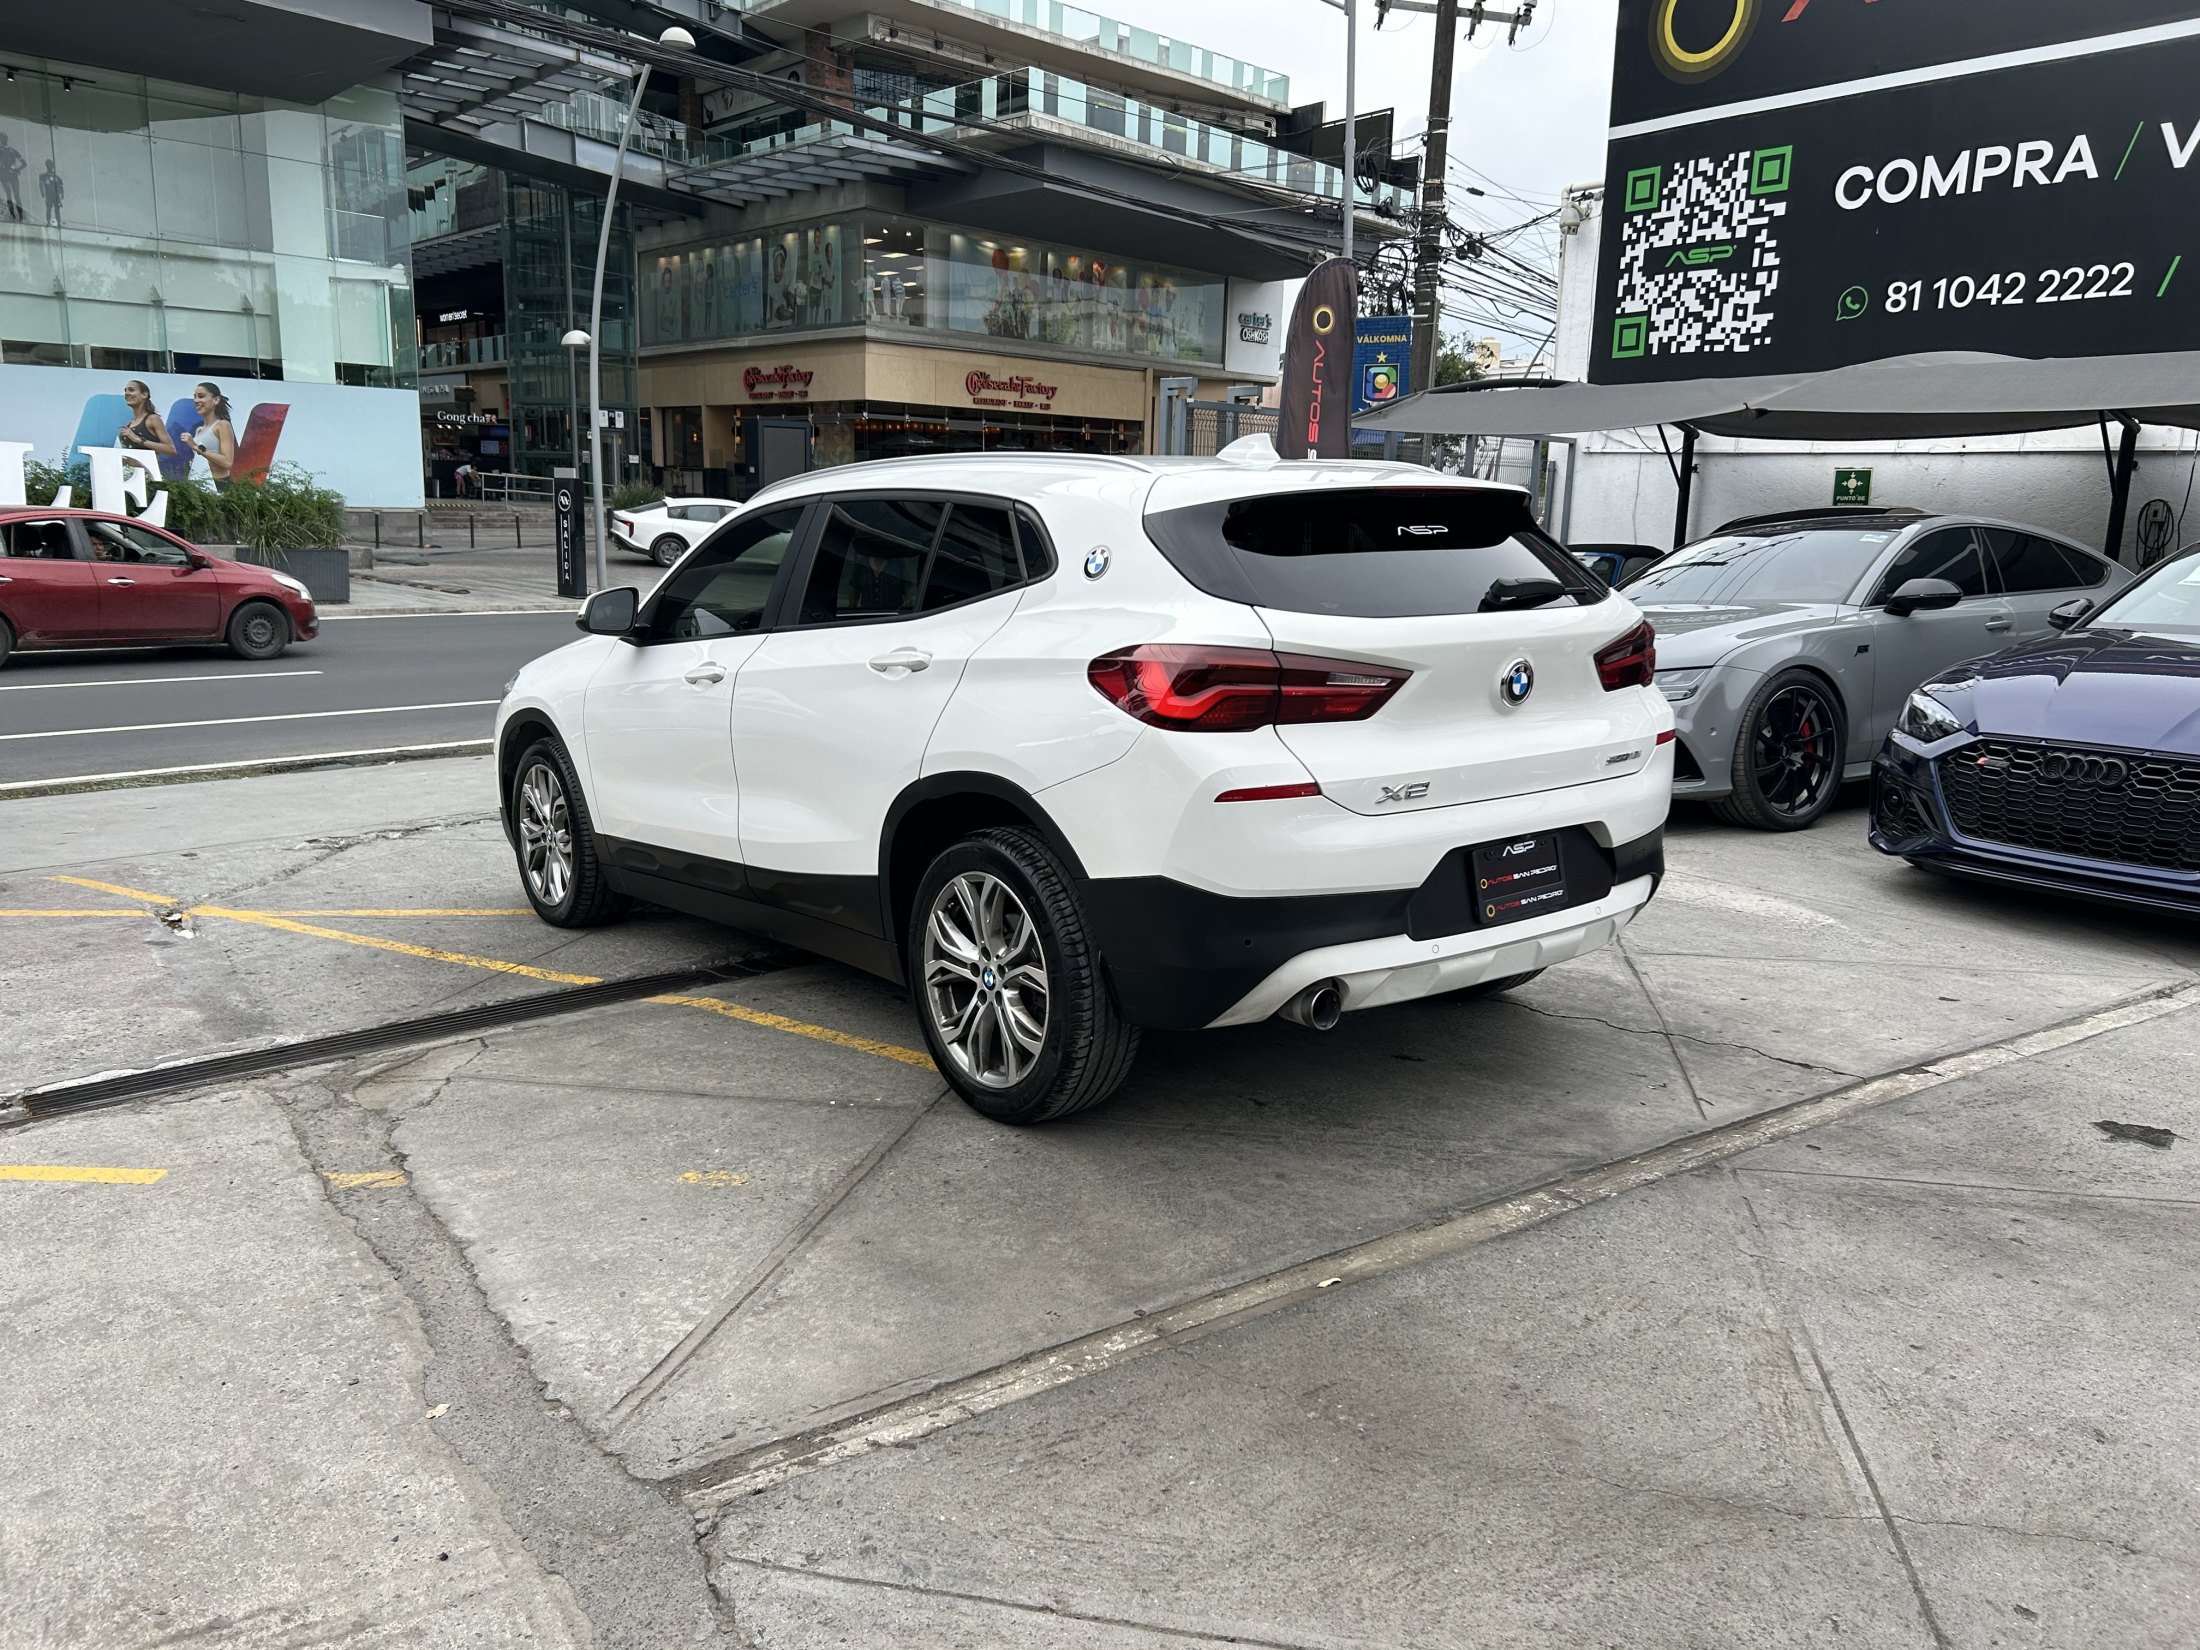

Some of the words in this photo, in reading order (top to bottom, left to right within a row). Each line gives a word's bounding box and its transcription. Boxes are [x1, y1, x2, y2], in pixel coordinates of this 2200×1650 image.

[1835, 134, 2099, 210] COMPRA
[1665, 245, 1733, 268] ASP
[1884, 280, 1922, 313] 81
[1932, 271, 2026, 310] 1042
[2035, 261, 2135, 303] 2222
[1356, 333, 1408, 344] VÄLKOMNA
[1016, 375, 1058, 401] Factory
[1307, 339, 1326, 443] AUTOS
[437, 410, 466, 425] Gong
[467, 412, 486, 423] cha
[562, 519, 571, 581] SALIDA
[1375, 781, 1431, 805] X2
[1502, 840, 1535, 857] ASP
